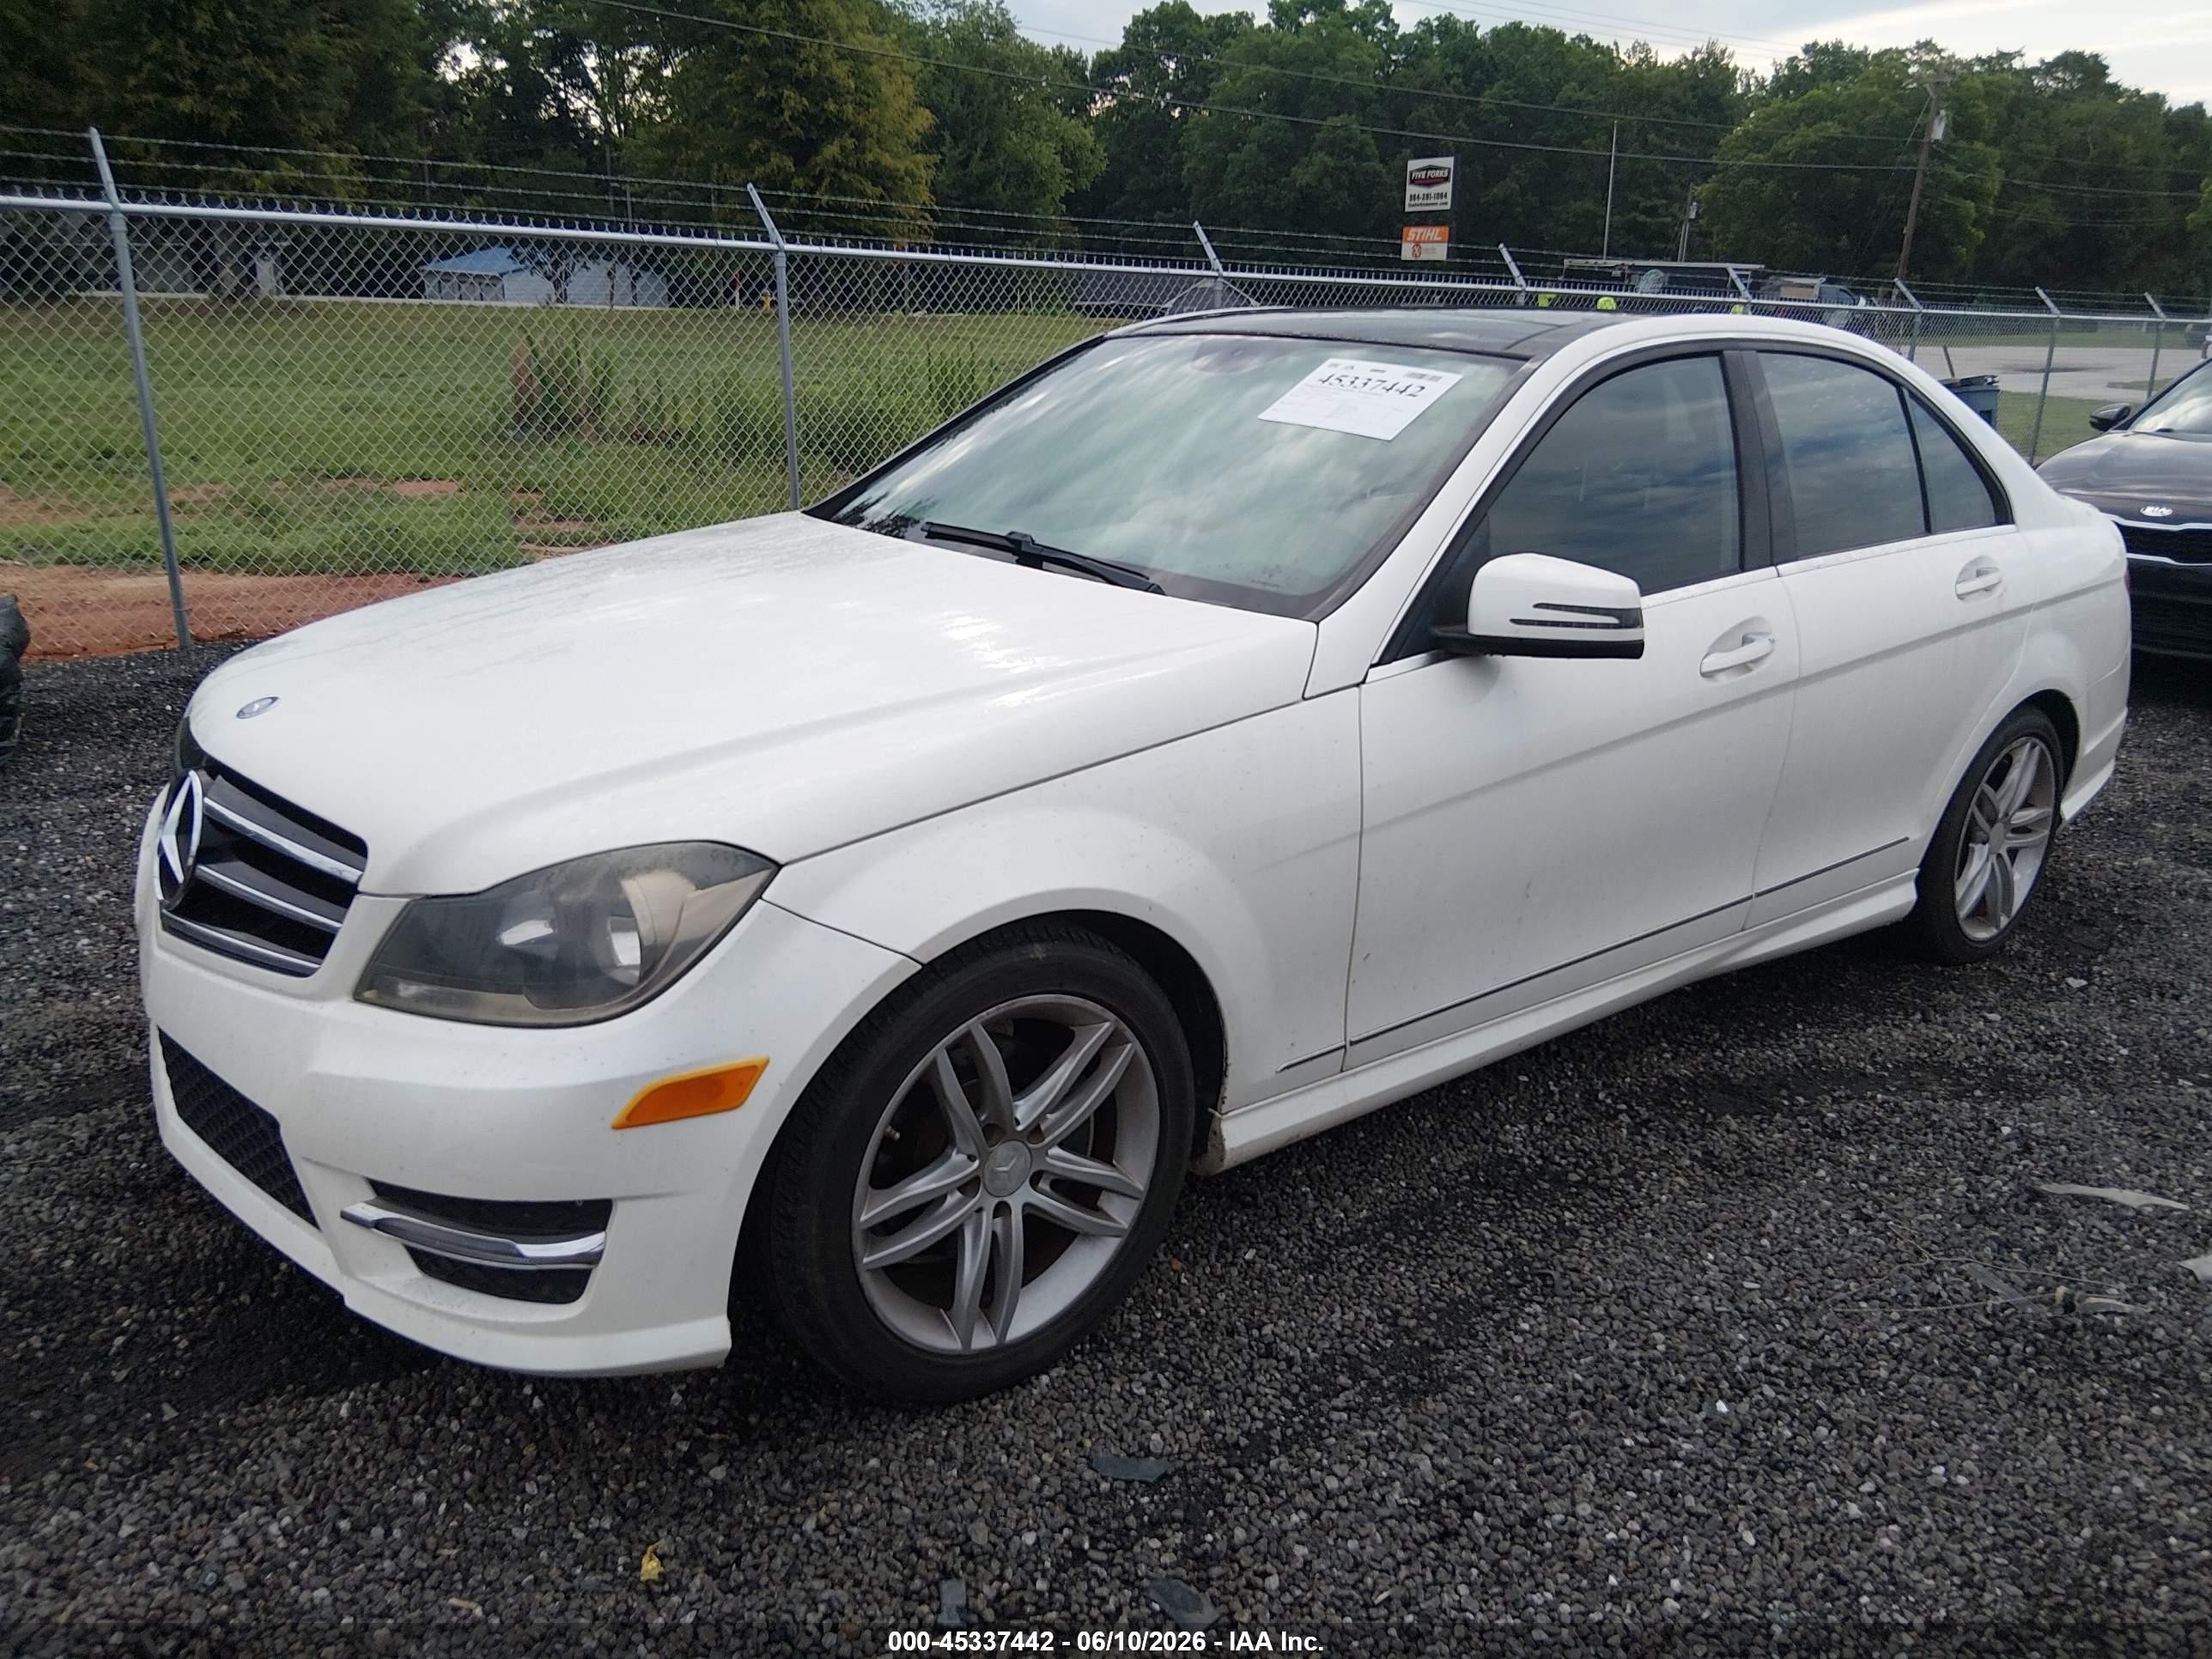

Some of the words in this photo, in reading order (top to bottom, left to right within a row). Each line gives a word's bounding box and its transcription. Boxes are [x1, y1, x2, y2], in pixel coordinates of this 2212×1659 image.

[1412, 171, 1427, 179] FIVE
[1426, 169, 1449, 179] FORKS
[1407, 228, 1443, 241] STIHL
[1318, 374, 1425, 398] 45337442
